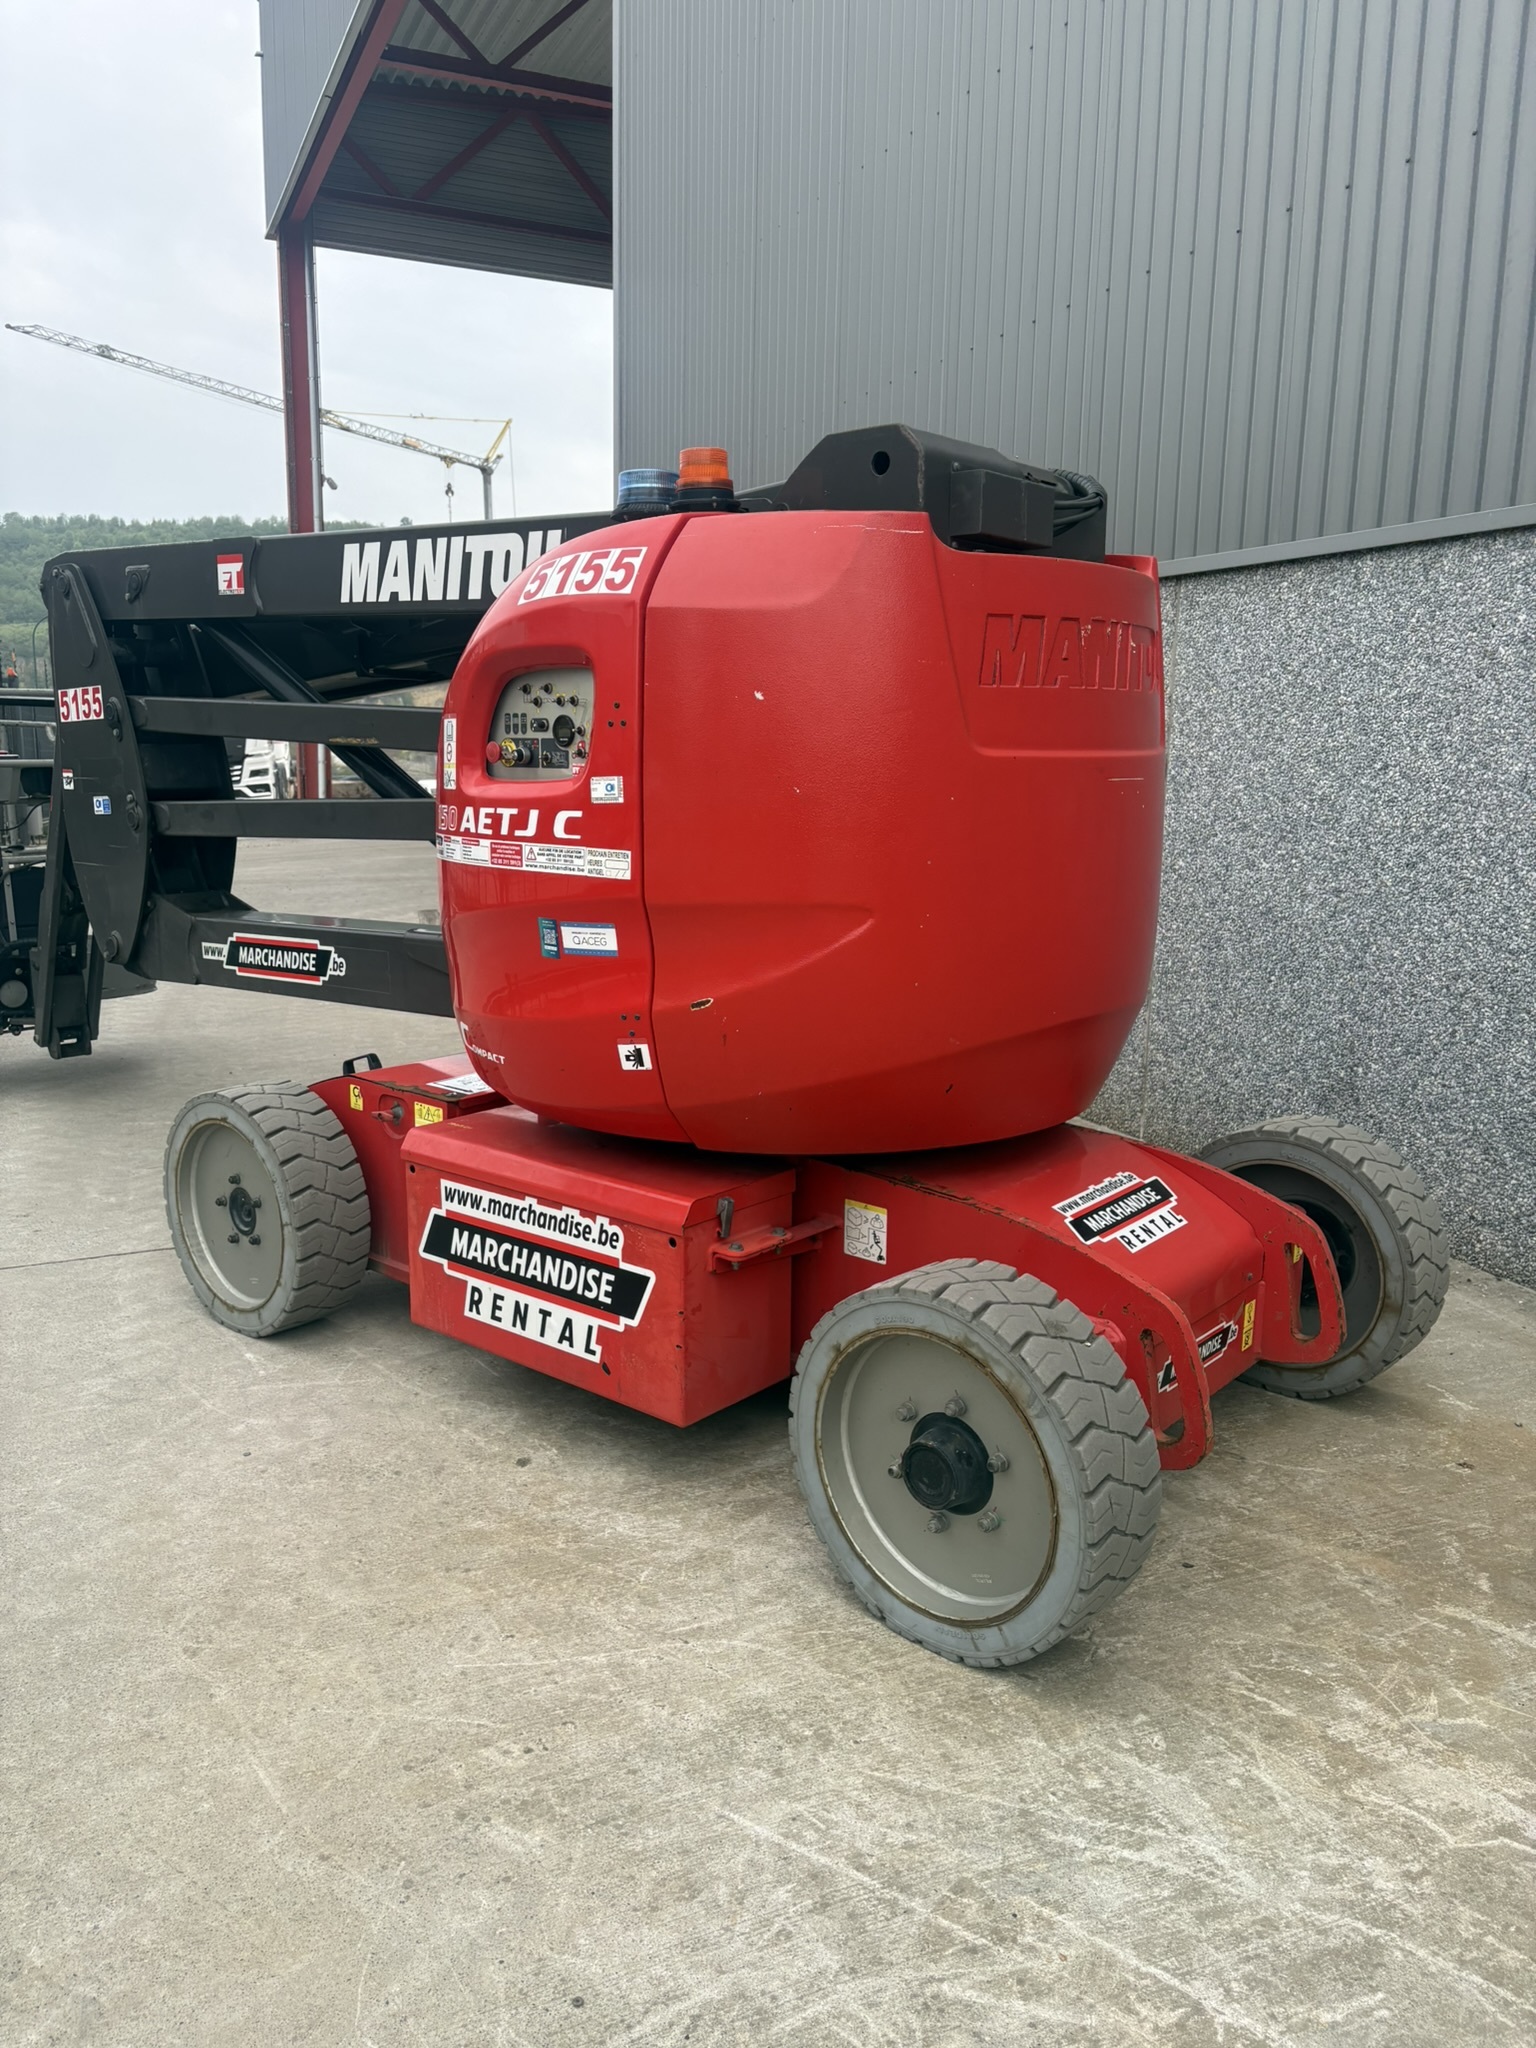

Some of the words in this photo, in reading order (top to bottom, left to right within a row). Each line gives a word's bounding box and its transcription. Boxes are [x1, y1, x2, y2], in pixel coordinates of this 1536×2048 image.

[523, 549, 644, 601] 5155
[59, 687, 103, 722] 5155
[553, 810, 583, 840] C
[525, 863, 585, 873] www.marchandise.be
[238, 946, 317, 972] MARCHANDISE
[1057, 1173, 1137, 1214] www.marchandise.be
[1082, 1186, 1162, 1233] MARCHANDISE
[444, 1185, 620, 1250] www.marchandise.be
[1119, 1209, 1184, 1250] RENTAL
[450, 1227, 616, 1305] MARCHANDISE
[468, 1285, 597, 1357] RENTAL
